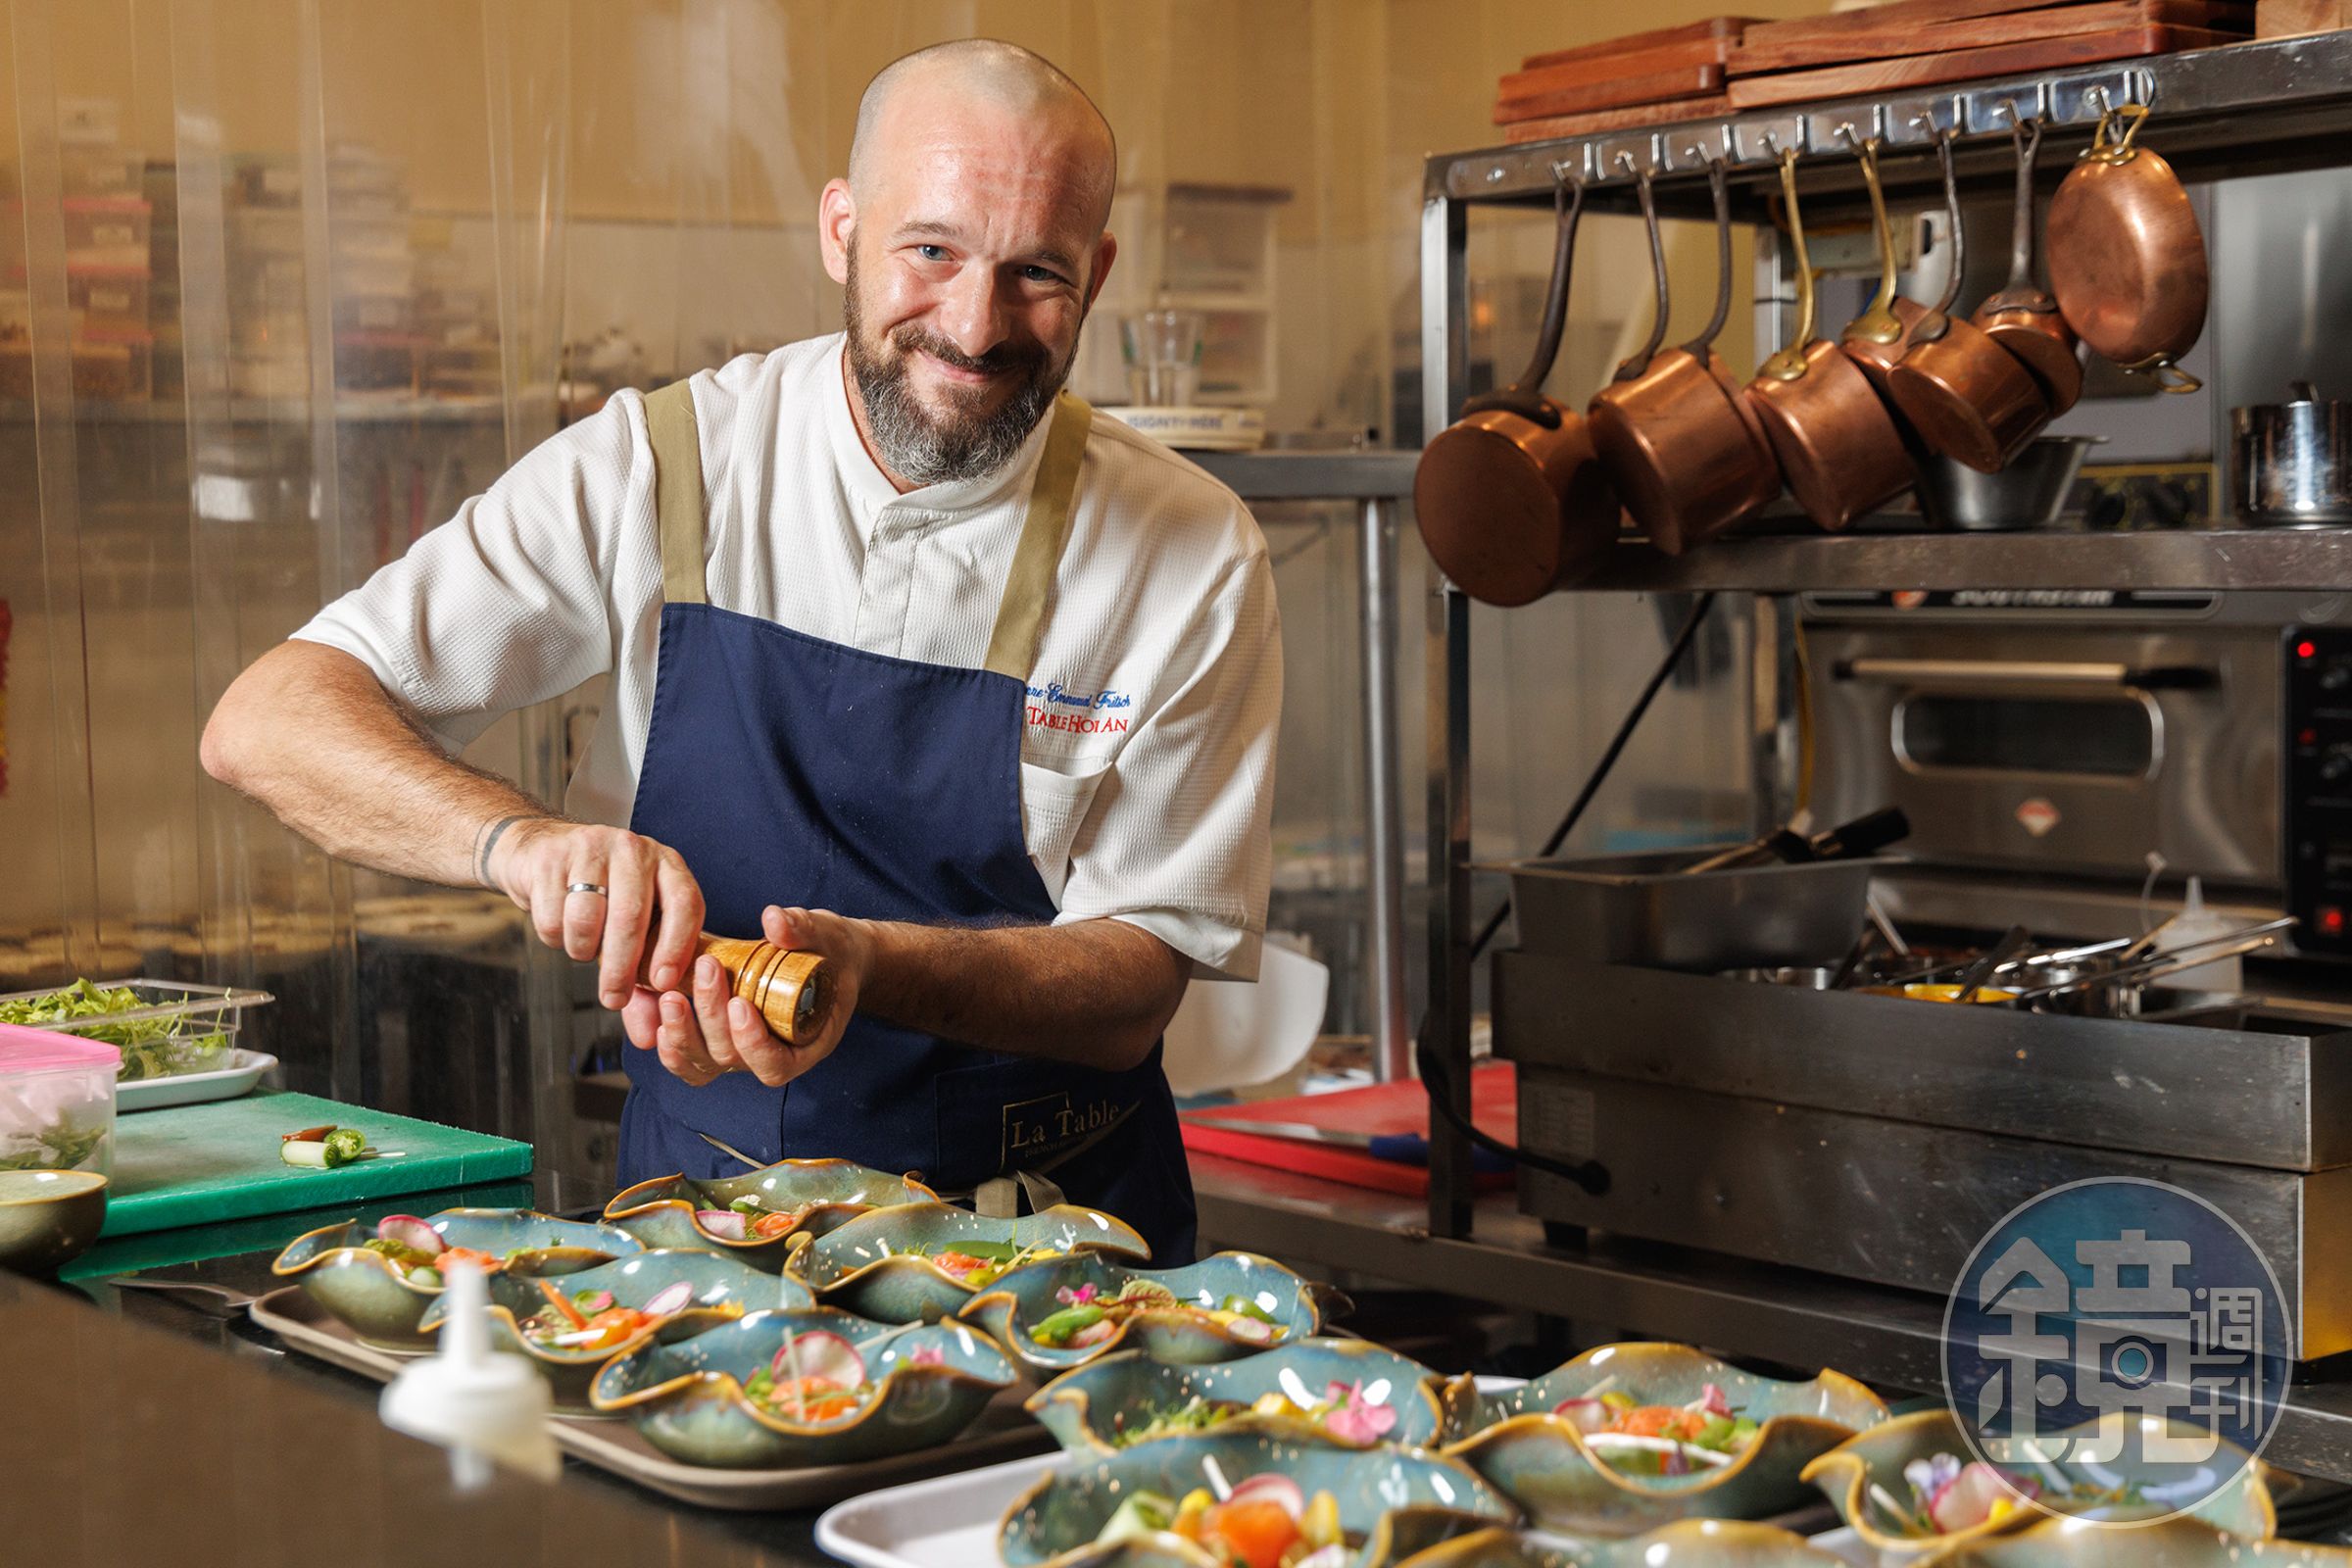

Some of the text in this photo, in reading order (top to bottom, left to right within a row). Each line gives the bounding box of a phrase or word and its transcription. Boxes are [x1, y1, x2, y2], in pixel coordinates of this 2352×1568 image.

[1026, 706, 1067, 730] TABLE
[1011, 1120, 1046, 1149] La
[1054, 1099, 1119, 1136] Table
